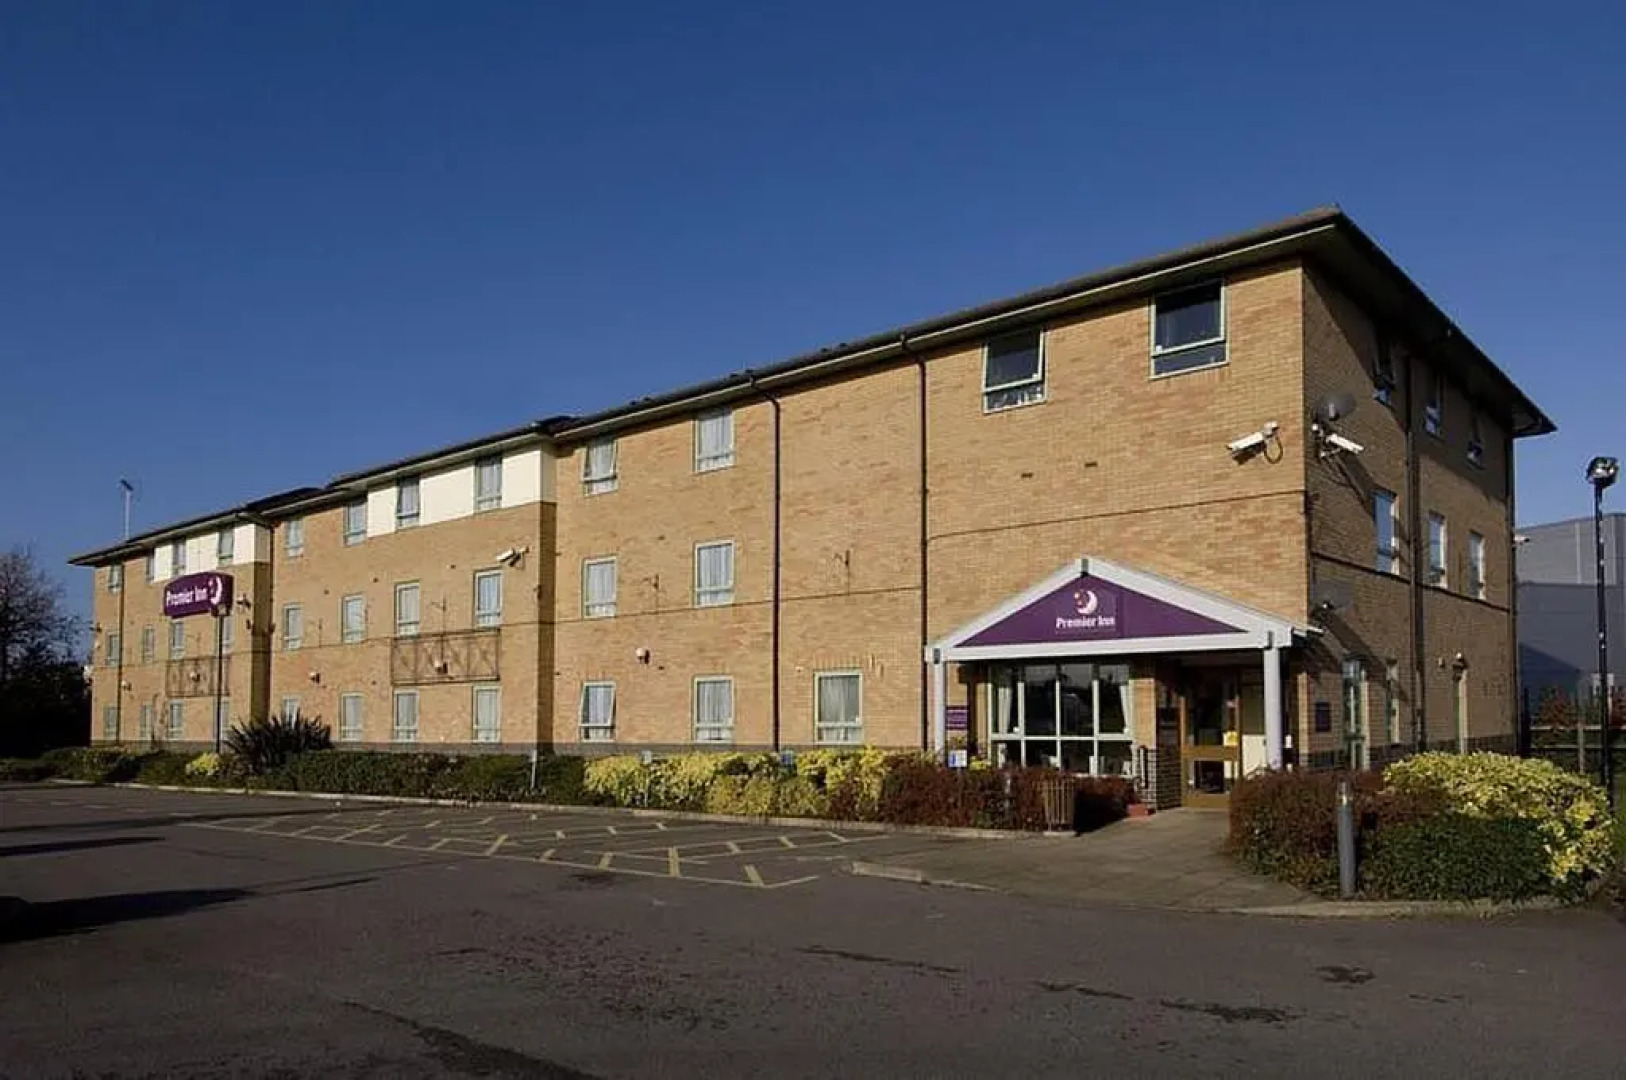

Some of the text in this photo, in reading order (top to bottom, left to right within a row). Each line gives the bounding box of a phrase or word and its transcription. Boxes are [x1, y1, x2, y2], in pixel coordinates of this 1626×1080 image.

[166, 586, 207, 606] Premier Inn
[1056, 615, 1115, 628] Premier Inn
